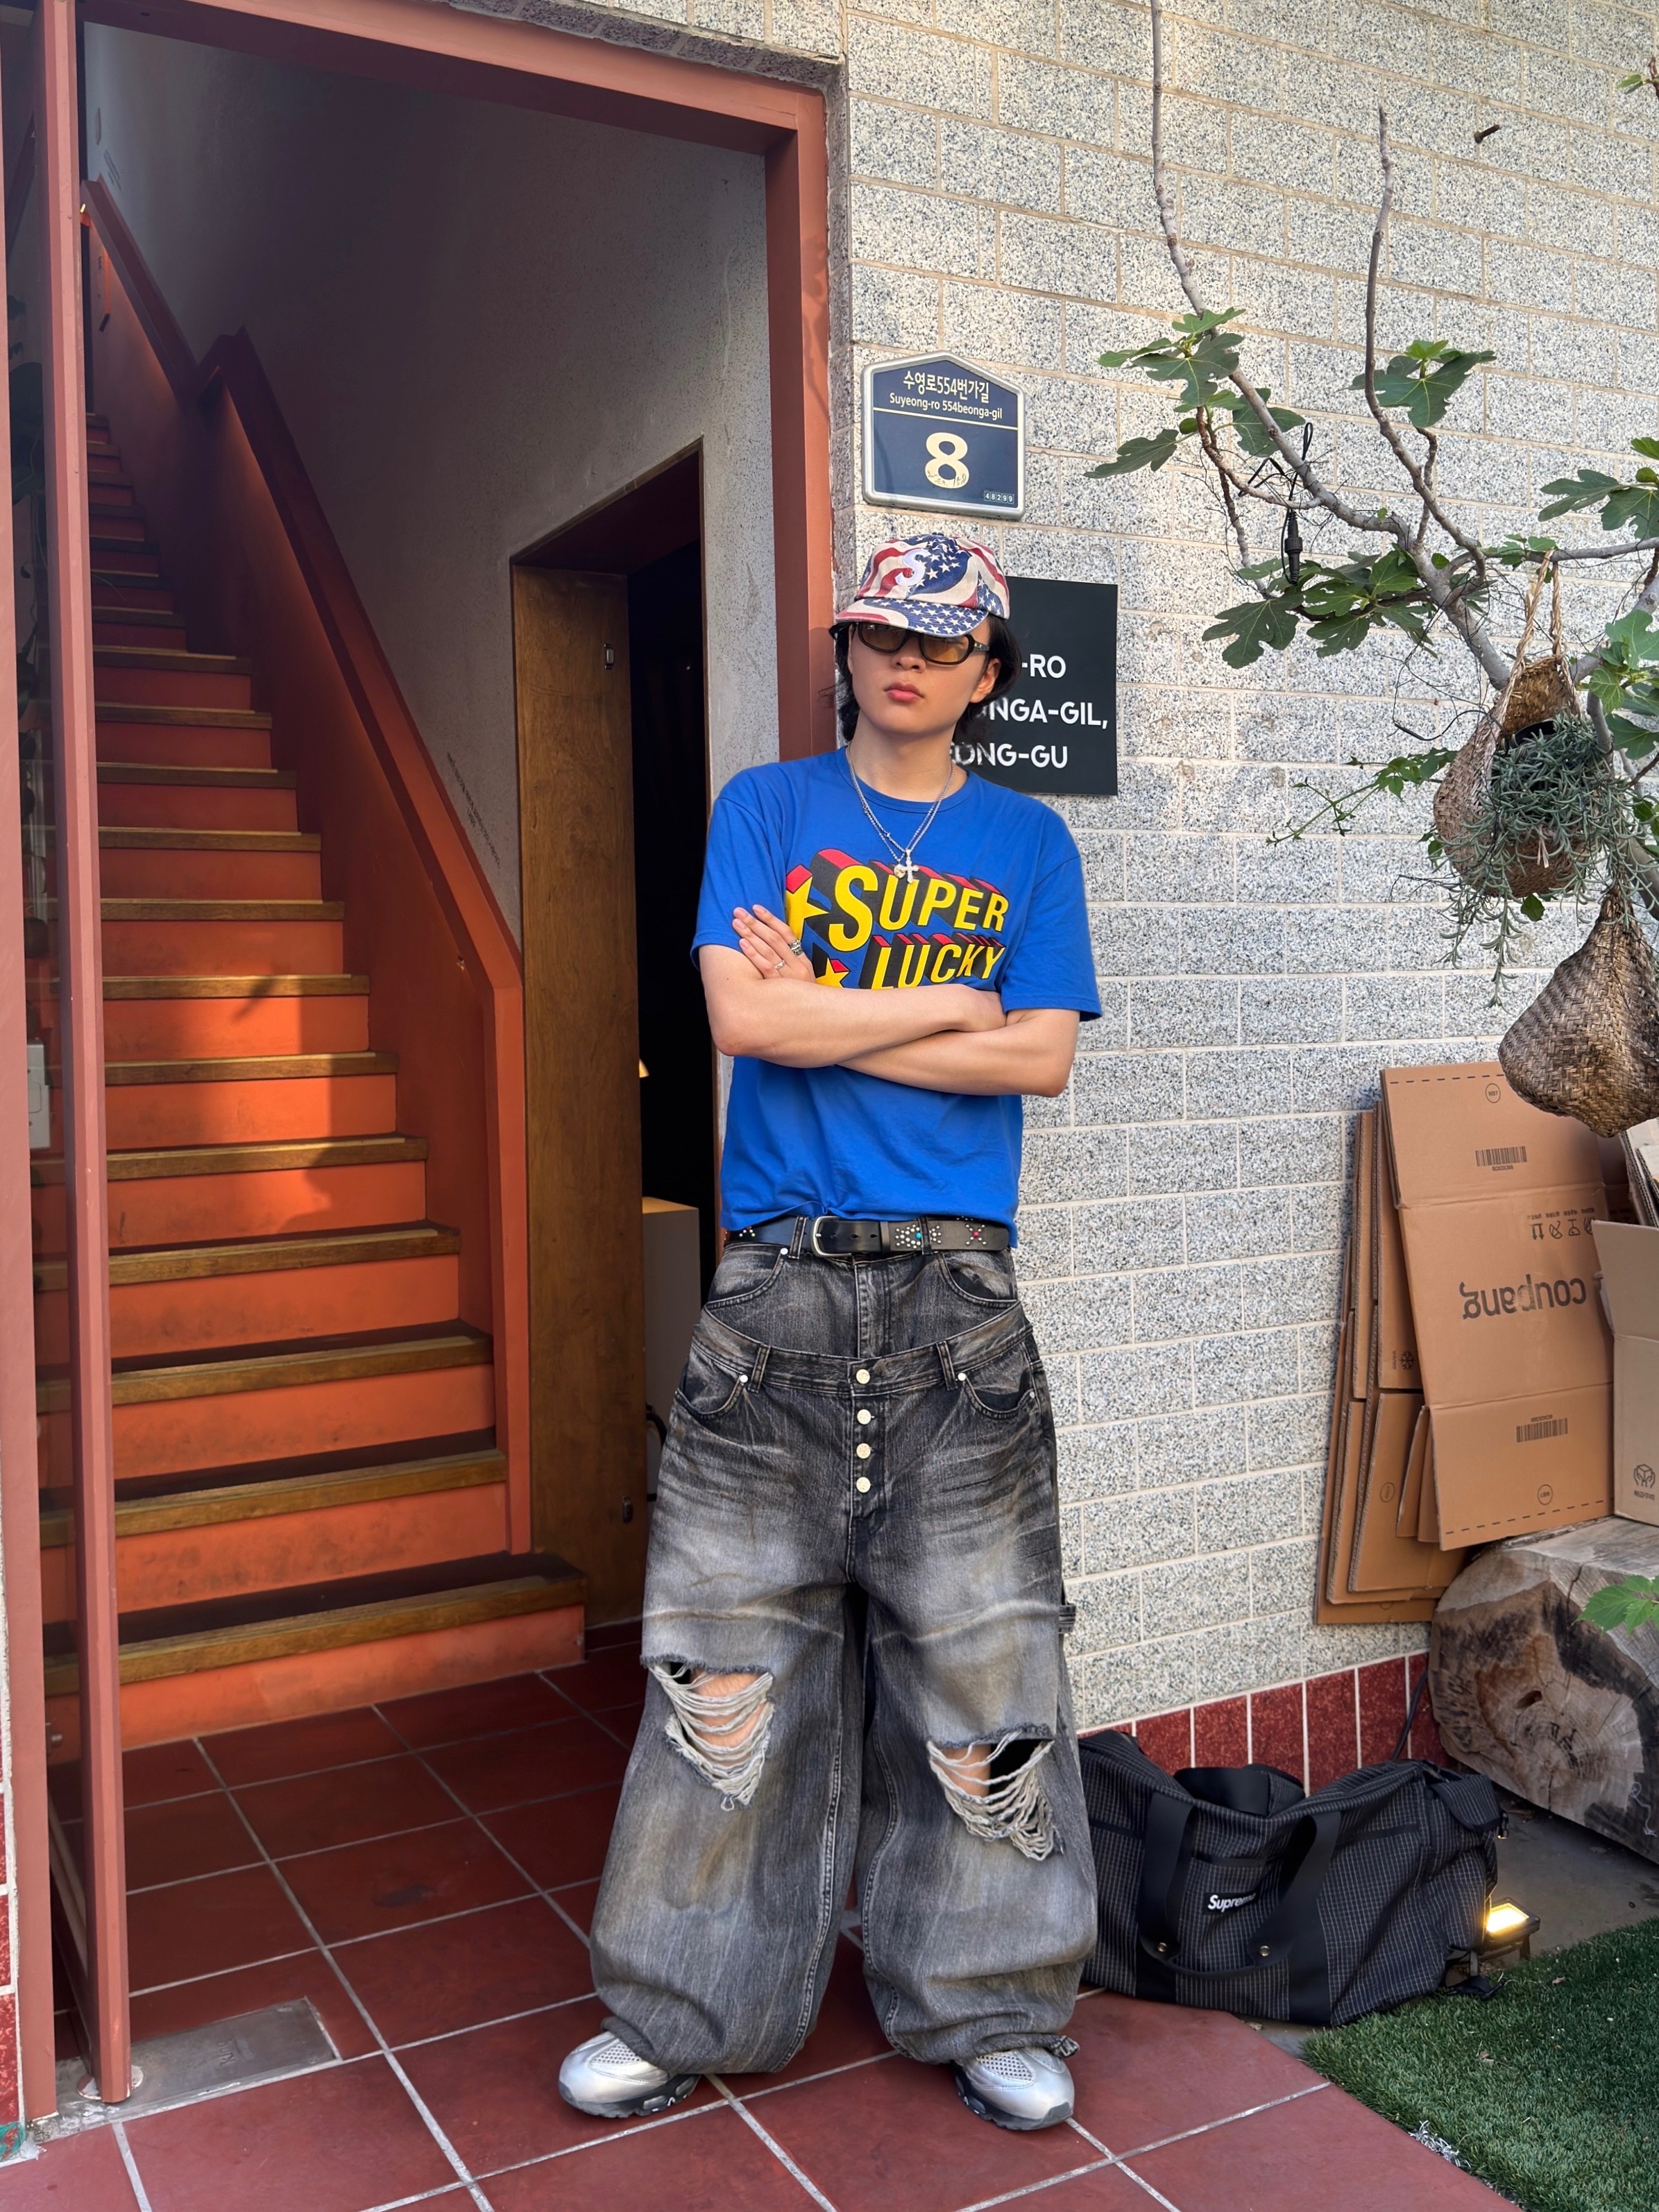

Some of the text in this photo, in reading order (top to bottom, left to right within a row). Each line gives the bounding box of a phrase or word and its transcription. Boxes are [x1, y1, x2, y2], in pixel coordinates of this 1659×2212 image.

[890, 392, 1003, 421] Suyeong-ro 554beonga-gil
[903, 371, 989, 404] 수영로554번가길
[924, 432, 970, 489] 8
[985, 492, 1013, 502] 48299
[976, 697, 1108, 729] NGA-GIL,
[828, 865, 1010, 952] SUPER
[871, 943, 1005, 990] LUCKY
[1459, 1274, 1587, 1320] coupang
